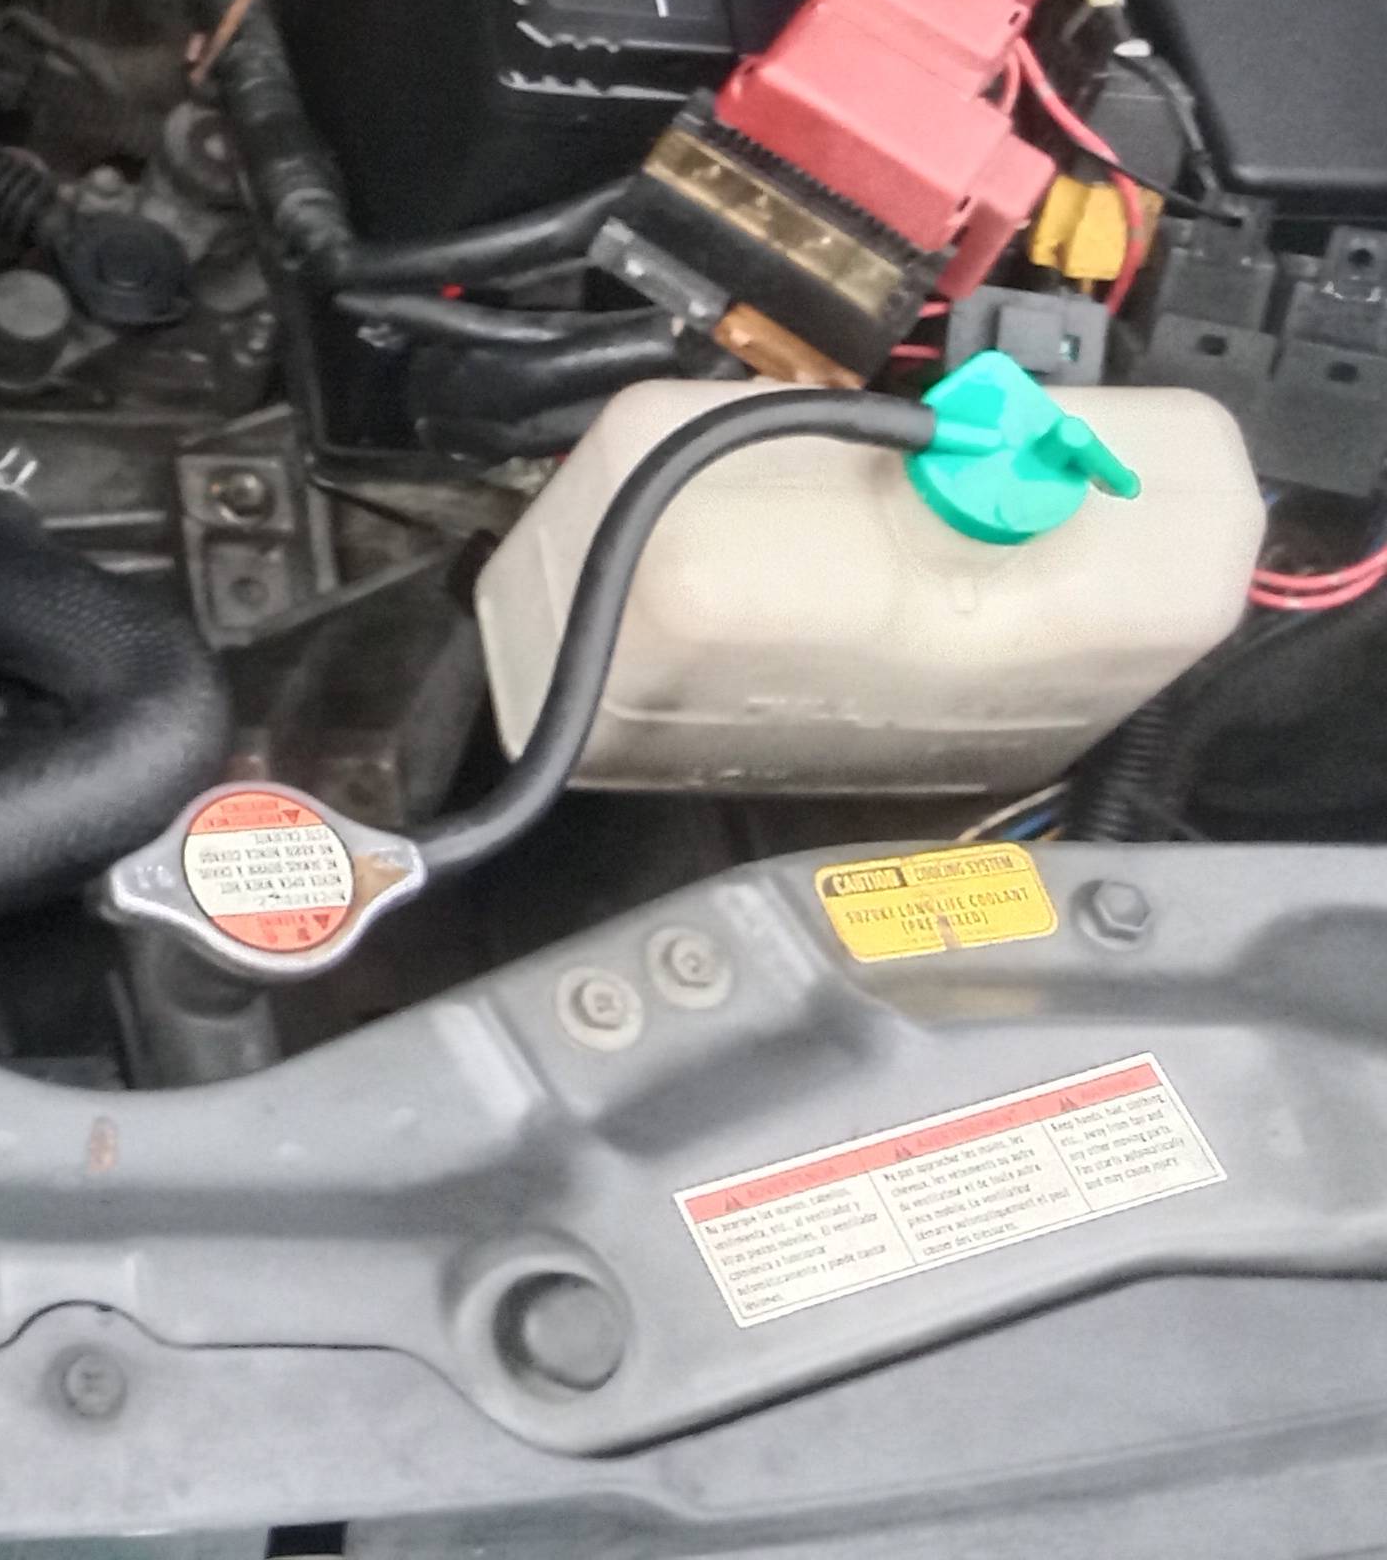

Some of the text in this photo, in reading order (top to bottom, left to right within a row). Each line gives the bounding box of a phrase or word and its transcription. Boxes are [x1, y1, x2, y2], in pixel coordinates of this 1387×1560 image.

[832, 856, 1013, 895] CAUTION COOLING SYSTEM
[845, 887, 1030, 924] SUZUKI LONG LIFE COOLANT
